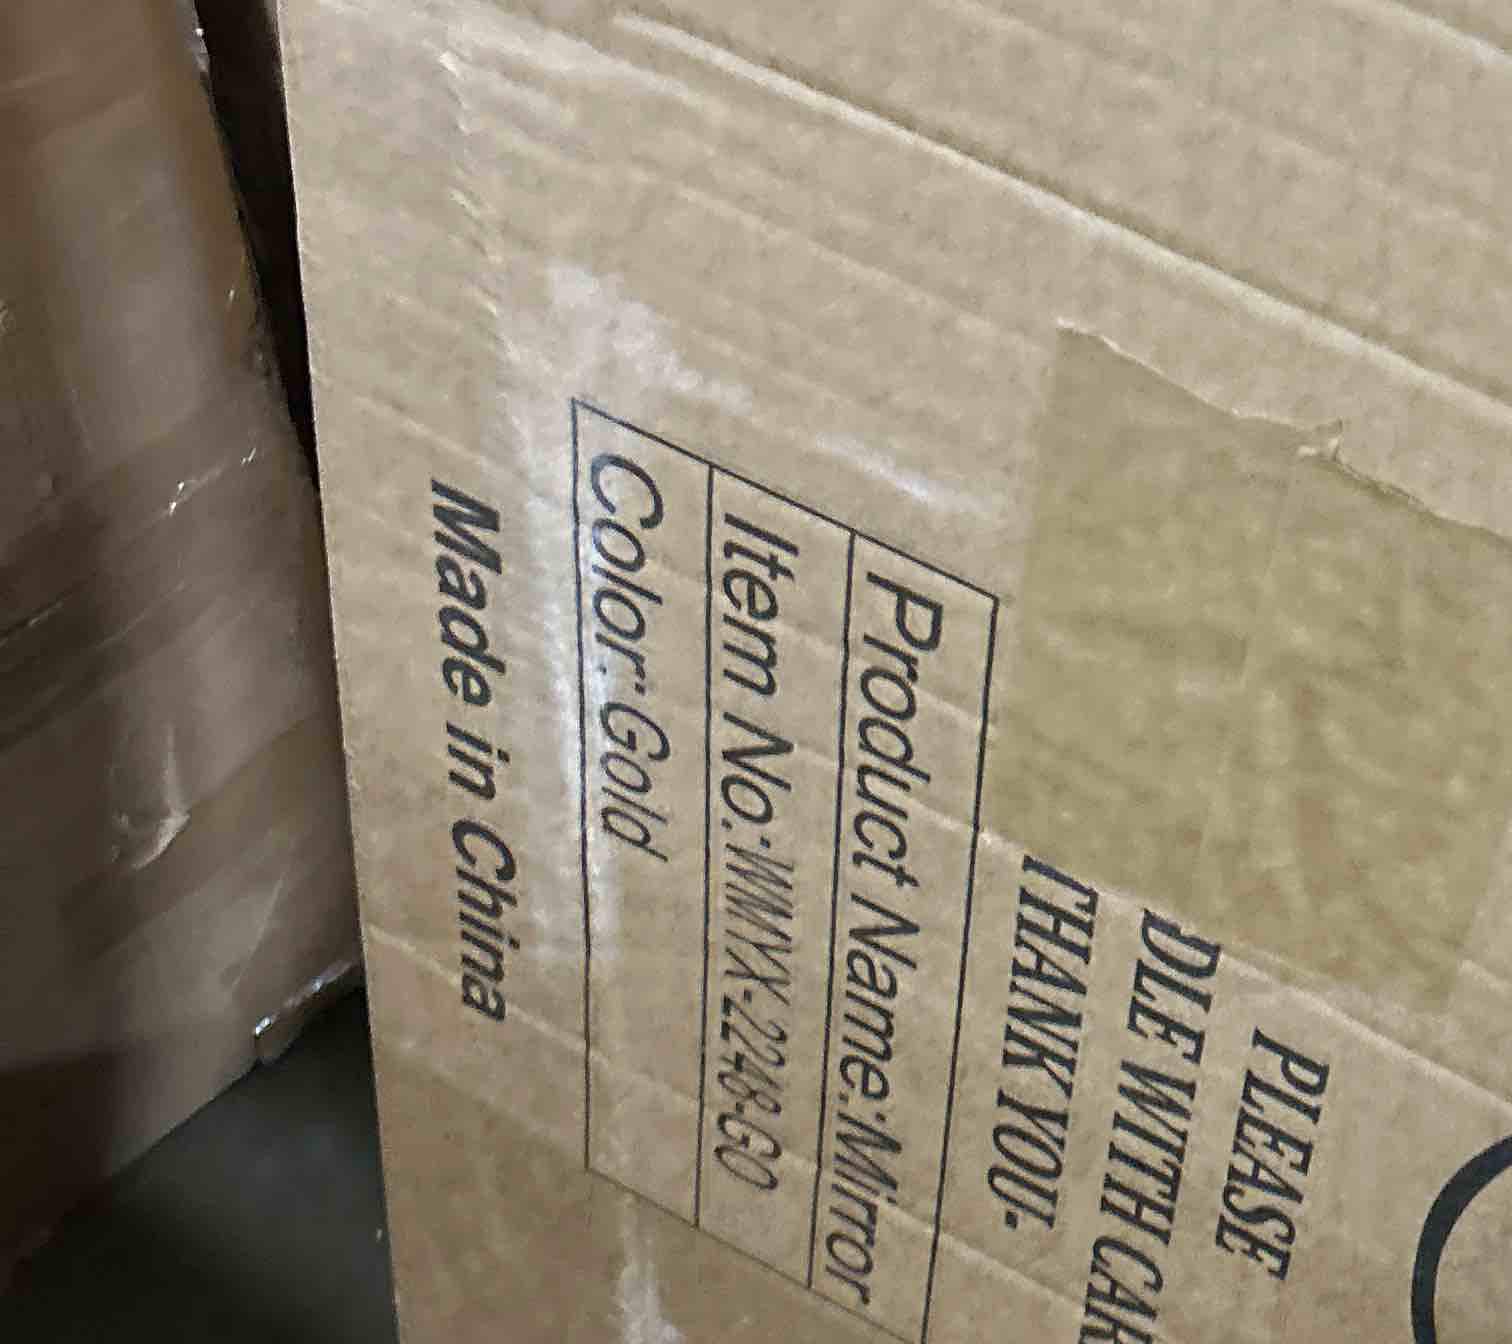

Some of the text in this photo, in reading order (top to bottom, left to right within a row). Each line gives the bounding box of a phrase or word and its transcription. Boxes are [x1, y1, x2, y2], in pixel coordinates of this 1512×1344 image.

[722, 512, 799, 697] Item
[853, 571, 943, 887] Product
[431, 480, 520, 1021] Made in China
[1100, 1048, 1202, 1241] WITH
[1216, 1027, 1329, 1280] PLEASE
